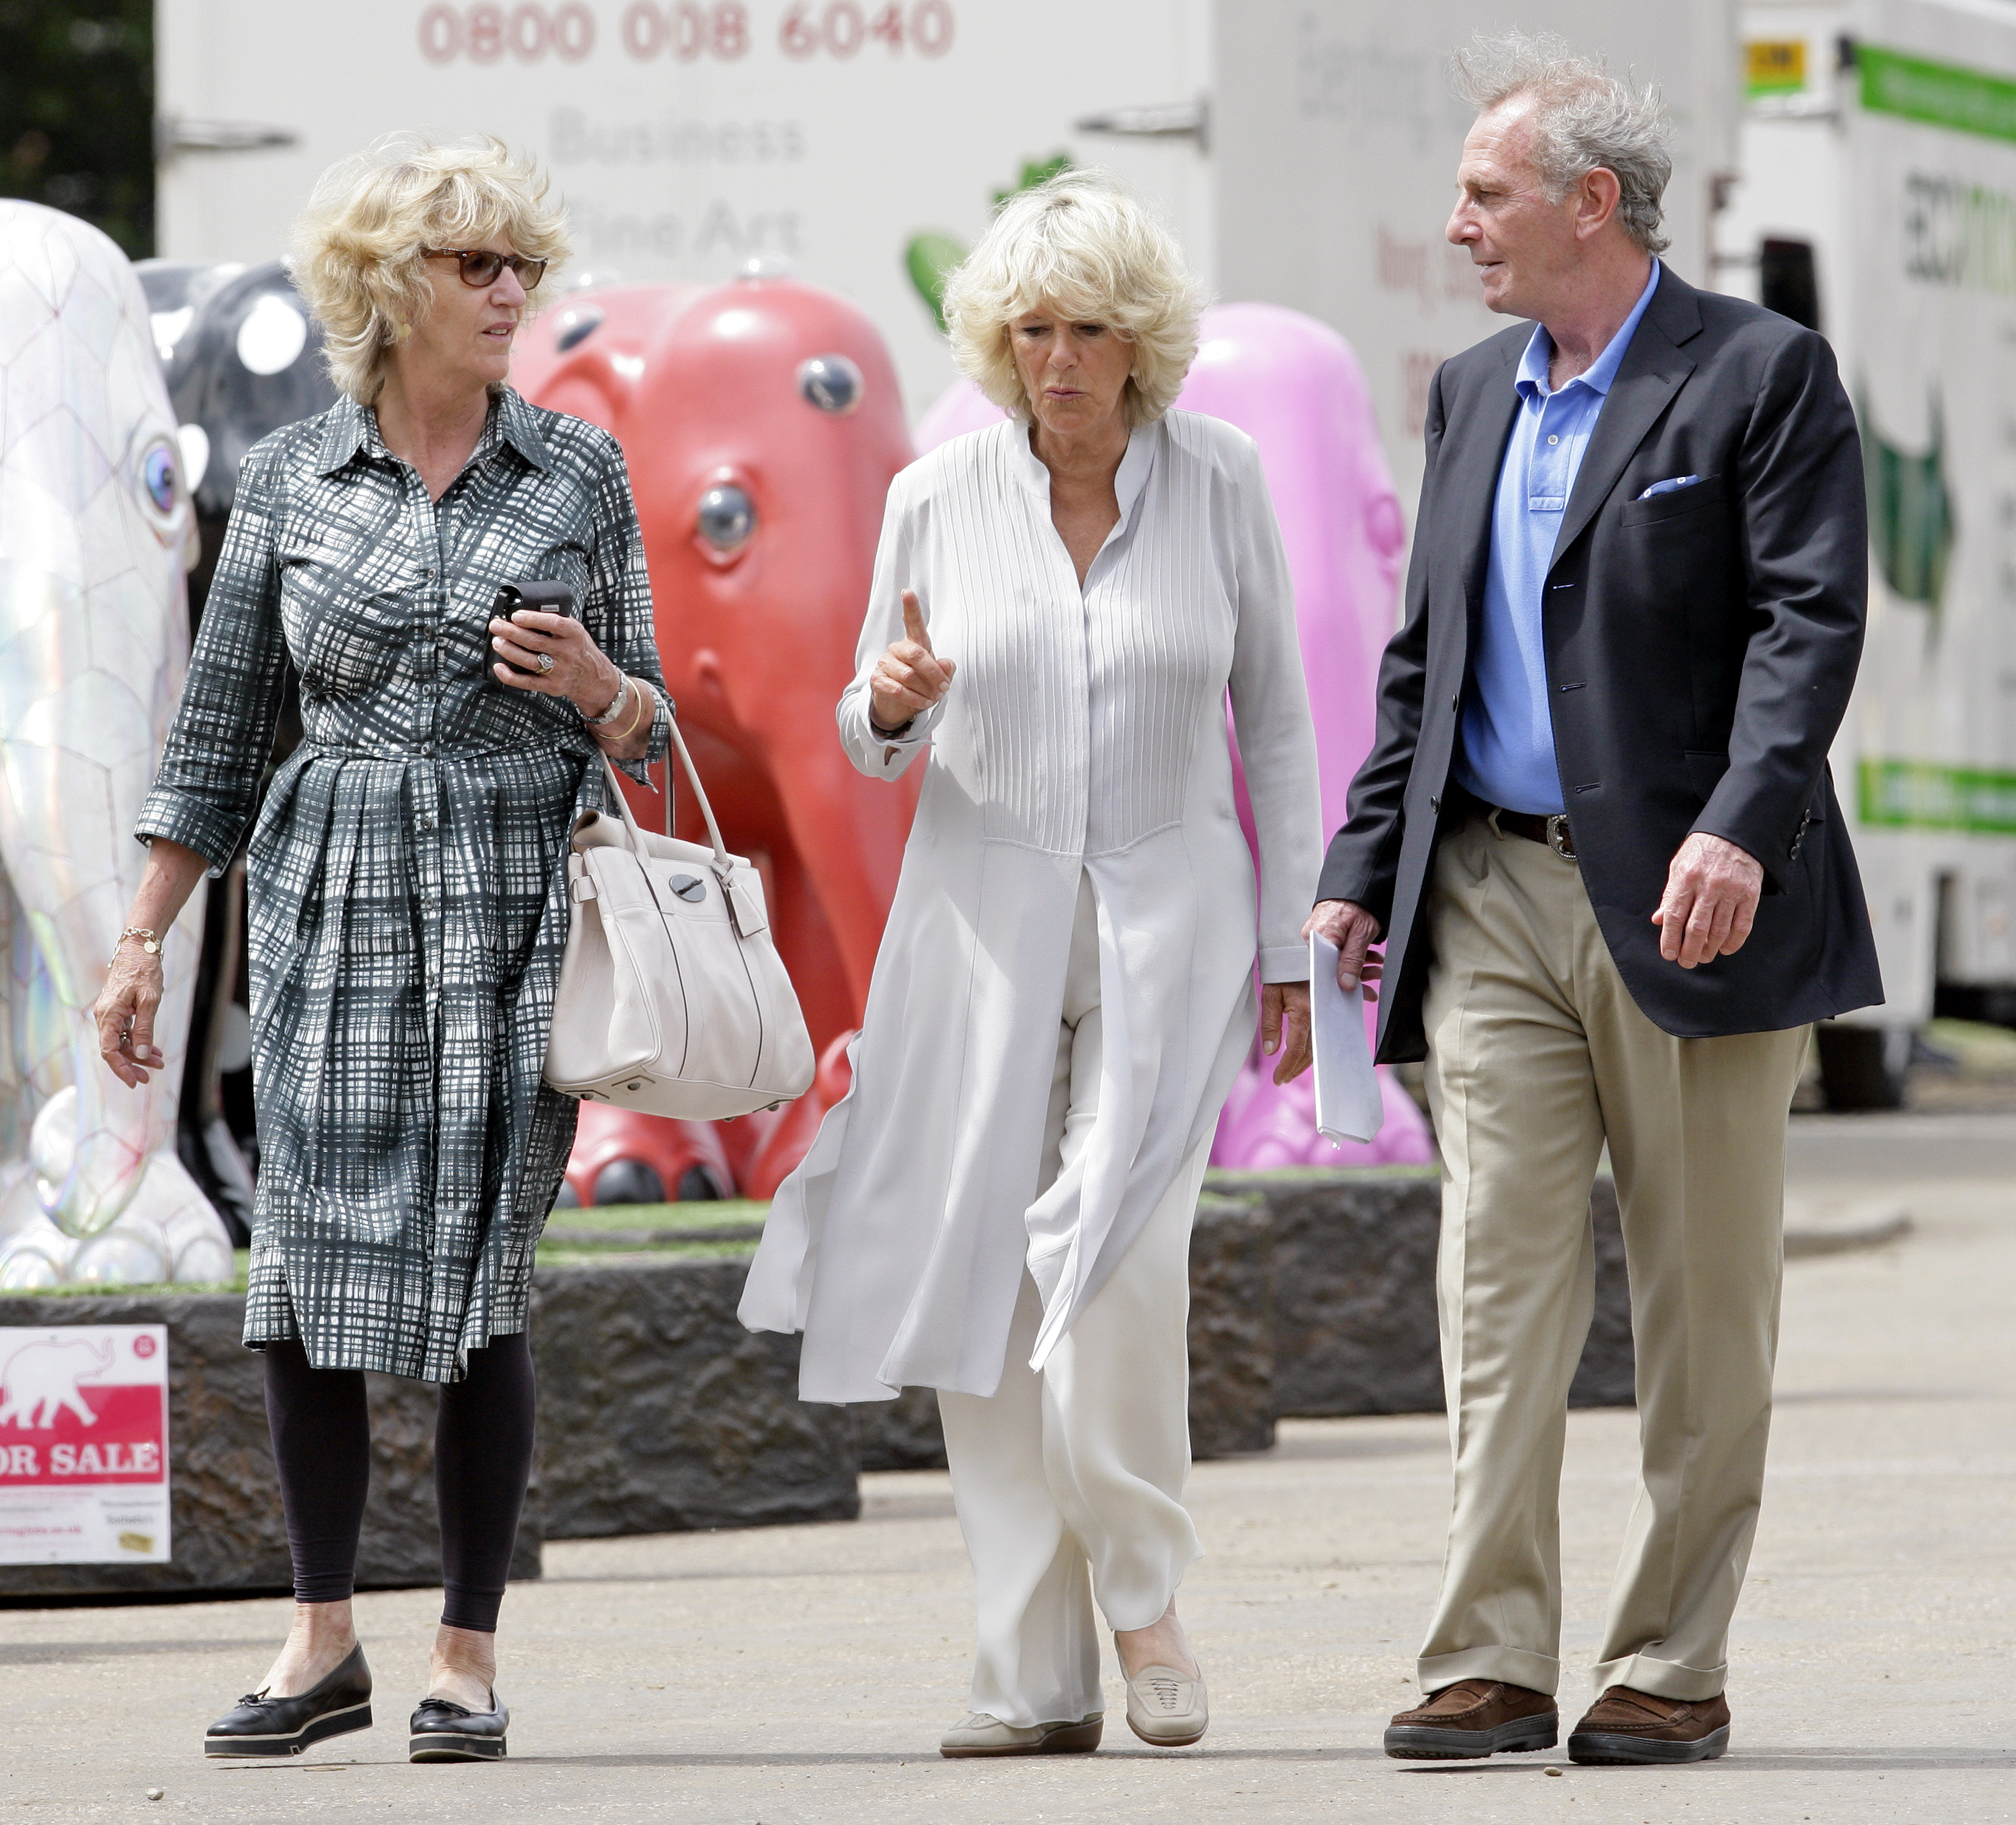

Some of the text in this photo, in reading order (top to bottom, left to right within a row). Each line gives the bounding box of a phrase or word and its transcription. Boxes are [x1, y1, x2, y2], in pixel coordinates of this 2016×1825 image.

[418, 0, 955, 63] 0800 008 6040
[548, 105, 807, 167] Business
[691, 196, 801, 256] Art
[49, 1442, 159, 1475] SALE
